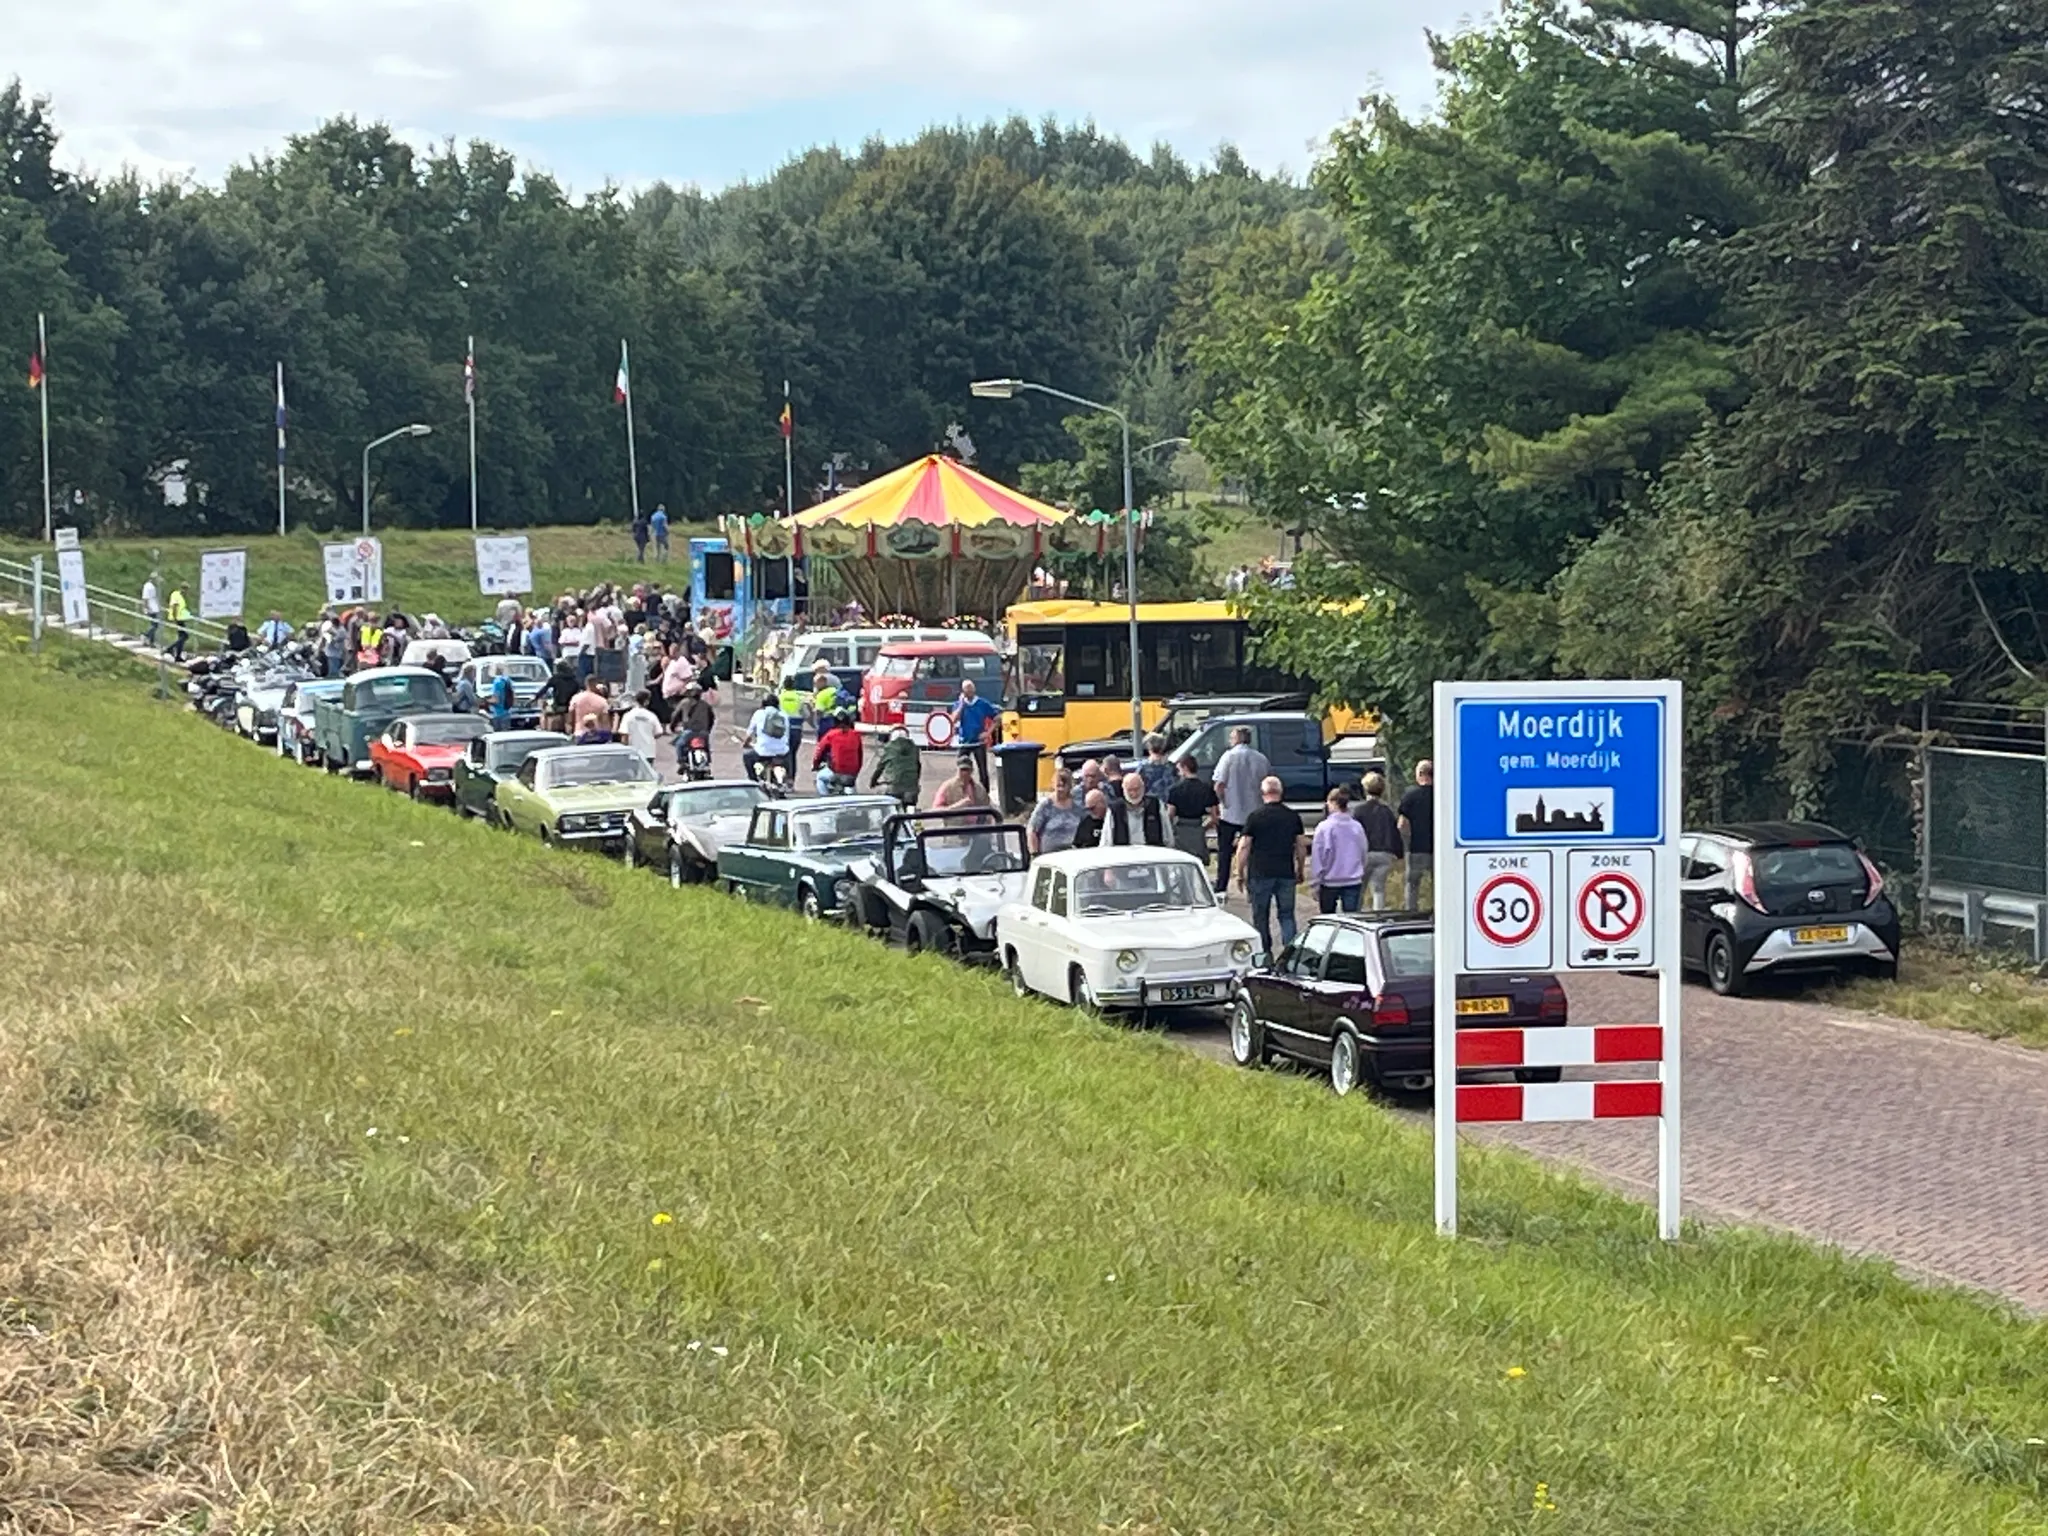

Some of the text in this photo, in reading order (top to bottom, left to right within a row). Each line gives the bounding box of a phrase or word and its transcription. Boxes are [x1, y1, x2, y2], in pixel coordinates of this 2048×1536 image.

[1498, 709, 1624, 747] Moerdijk
[1499, 751, 1621, 774] gem. Moerdijk
[1488, 857, 1529, 870] ZONE
[1591, 855, 1631, 867] ZONE
[1488, 898, 1530, 923] 30
[1600, 887, 1628, 929] P
